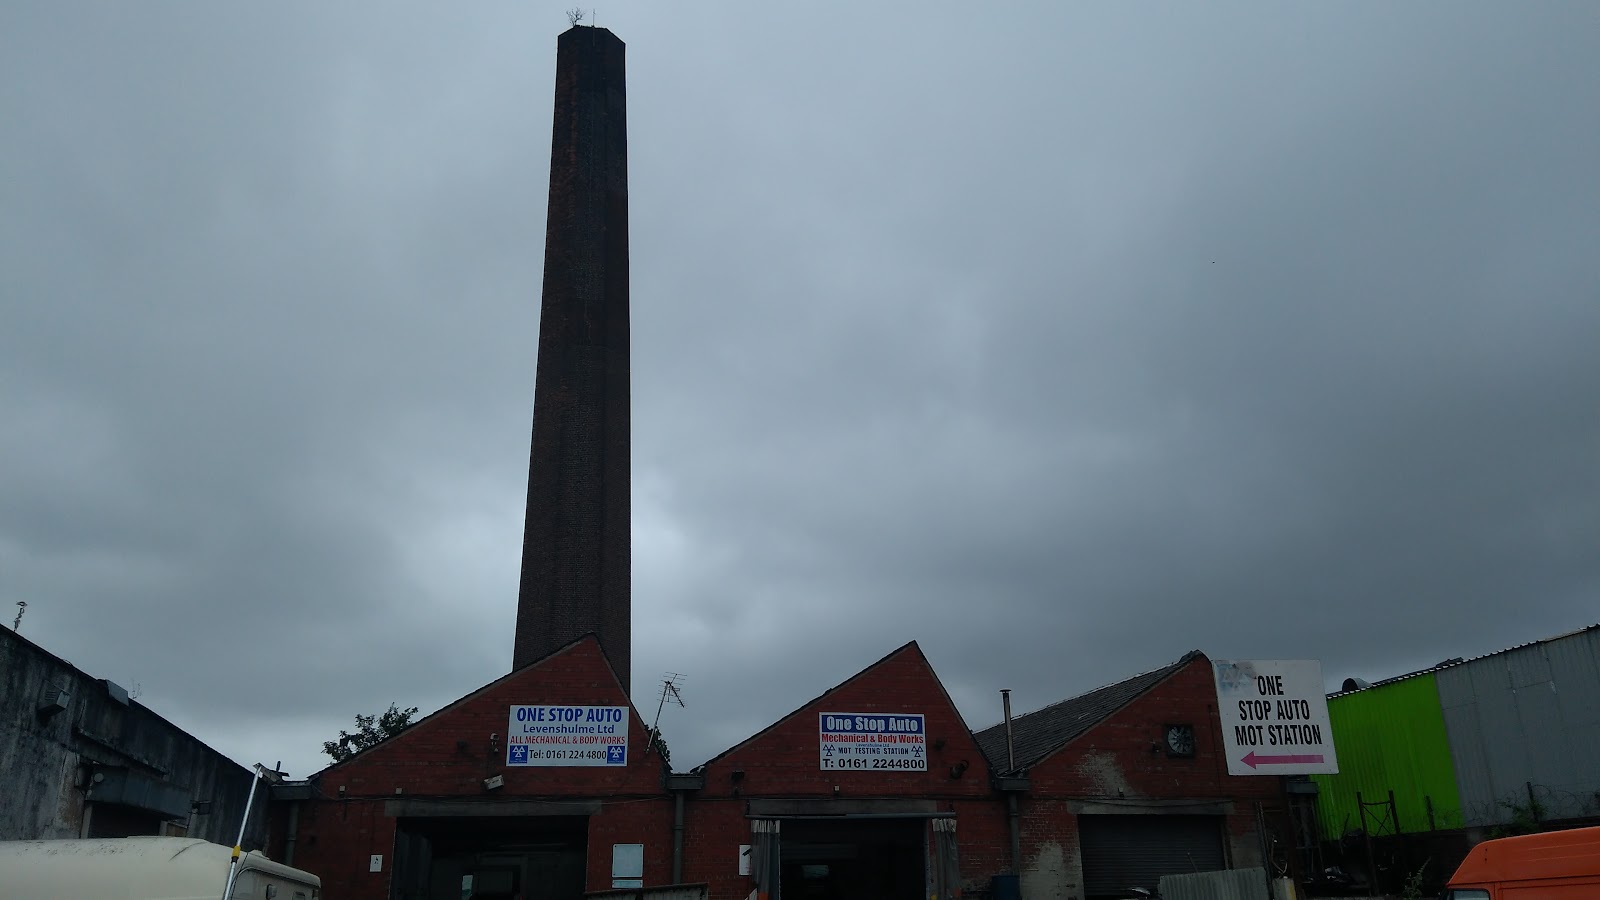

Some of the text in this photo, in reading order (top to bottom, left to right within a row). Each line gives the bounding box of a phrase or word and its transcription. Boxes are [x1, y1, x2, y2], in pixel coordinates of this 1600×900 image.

[1258, 676, 1284, 695] ONE
[517, 707, 622, 722] ONE STOP AUTO
[1239, 700, 1309, 720] STOP AUTO
[524, 724, 614, 733] Levenshulme Ltd
[827, 716, 918, 732] One Stop Auto
[525, 736, 570, 744] MECHANICAL
[573, 736, 577, 744] &
[580, 736, 598, 744] BODY
[822, 734, 868, 742] Mechanical
[878, 735, 896, 743] Body
[1235, 725, 1322, 745] MOT STATION
[530, 750, 606, 759] Tel: 0161 224 4800
[823, 759, 924, 768] T: 0161 2244800
